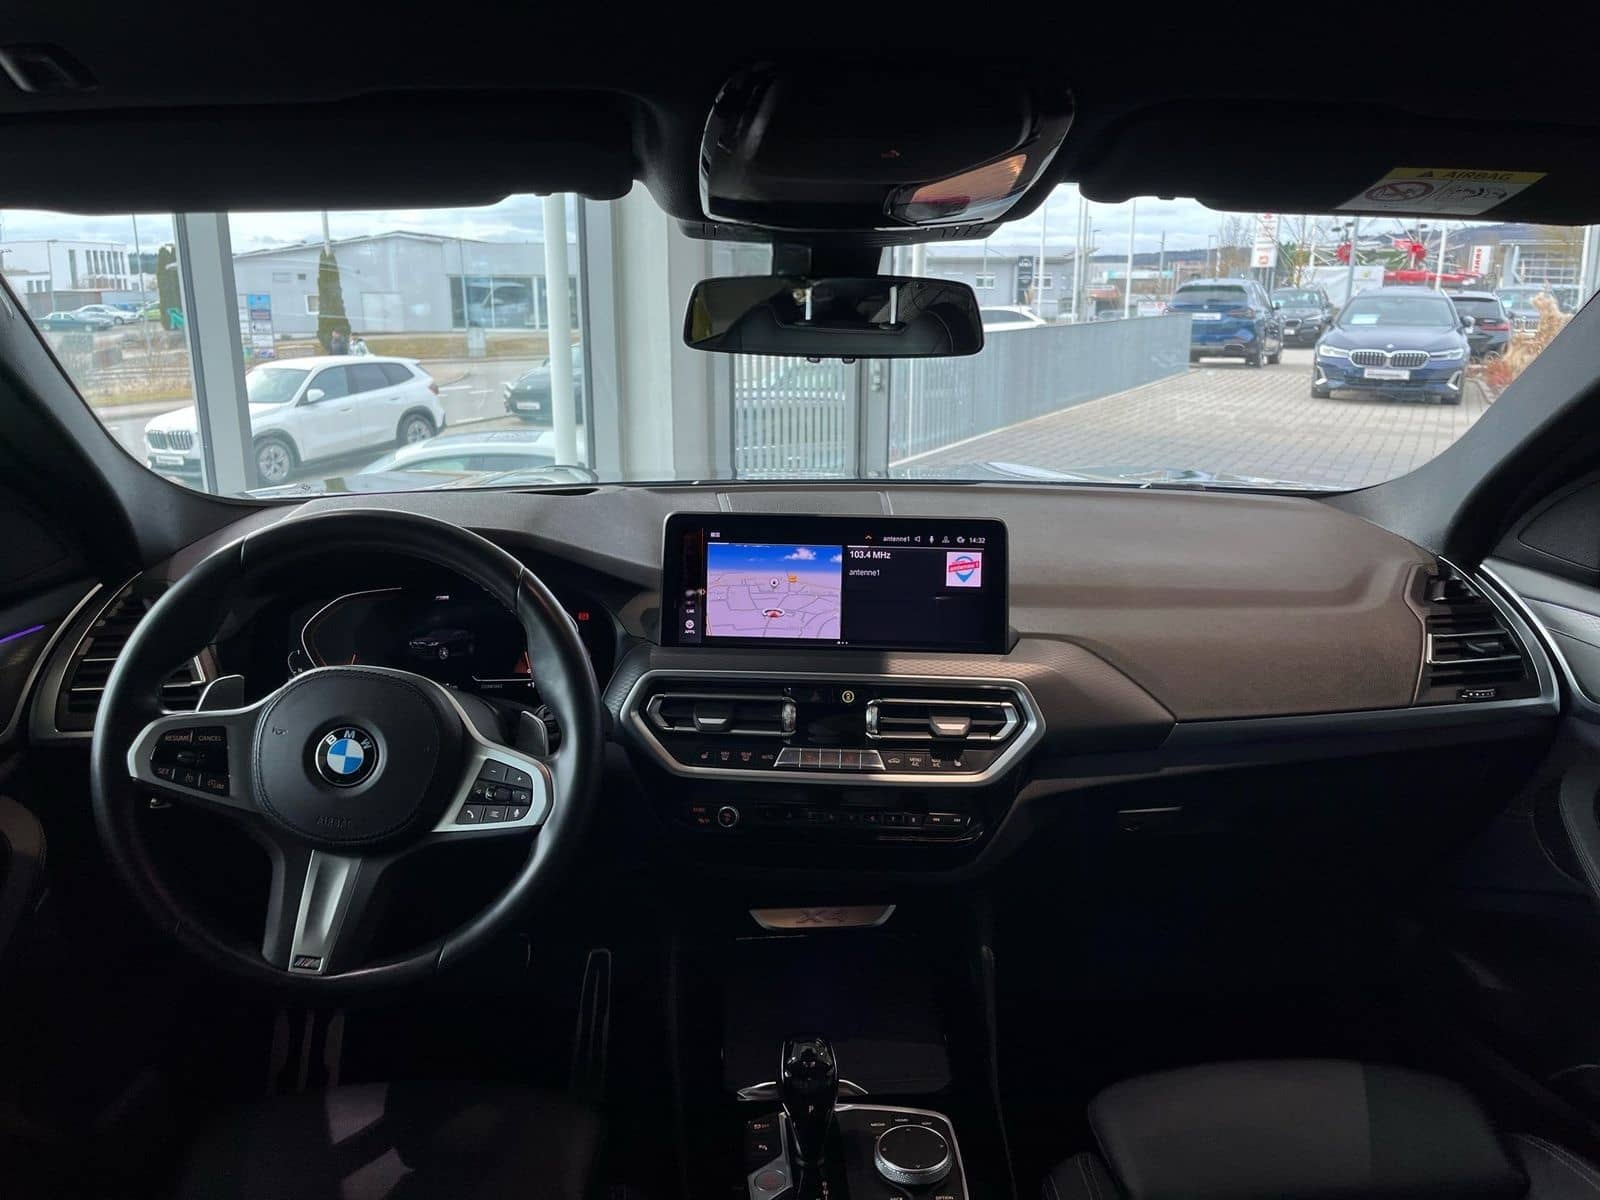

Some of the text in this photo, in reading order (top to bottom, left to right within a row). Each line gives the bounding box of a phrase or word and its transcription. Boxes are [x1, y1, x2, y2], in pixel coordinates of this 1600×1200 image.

[1443, 171, 1514, 181] AIRBAG
[849, 550, 891, 560] 103.4 MHz
[848, 568, 880, 576] antenne1
[324, 728, 373, 750] BMW
